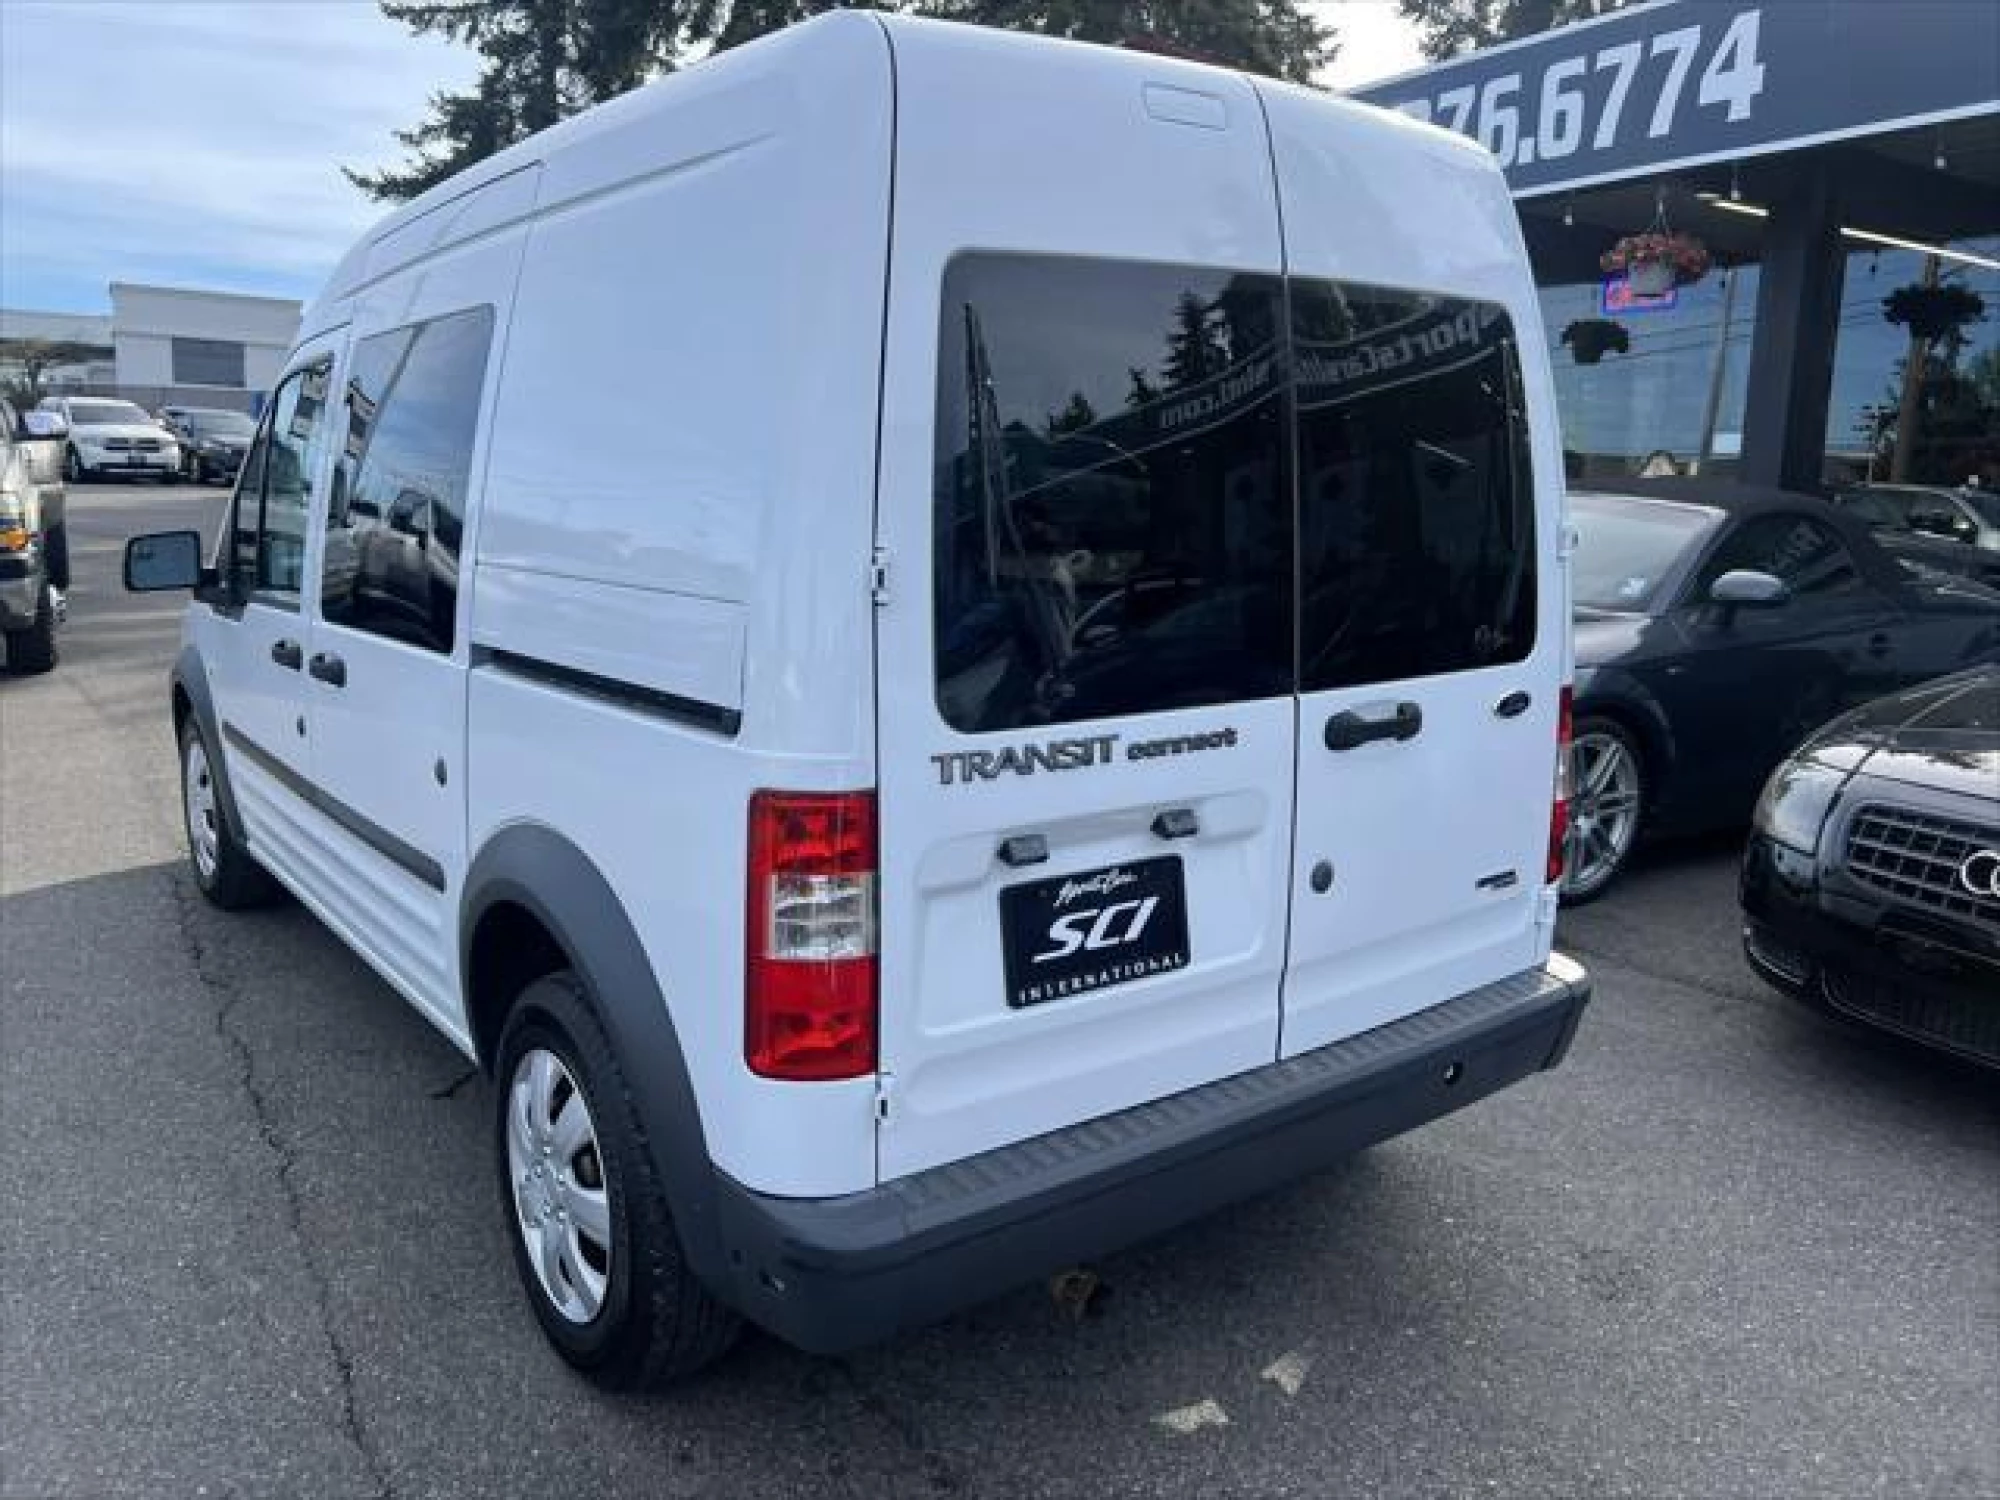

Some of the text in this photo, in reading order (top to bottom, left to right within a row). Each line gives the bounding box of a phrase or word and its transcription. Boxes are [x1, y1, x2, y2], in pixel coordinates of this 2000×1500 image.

[930, 727, 1238, 785] TRANSIT connect
[1032, 895, 1160, 963] SCI
[1018, 952, 1184, 1004] INTERNATIONAL
